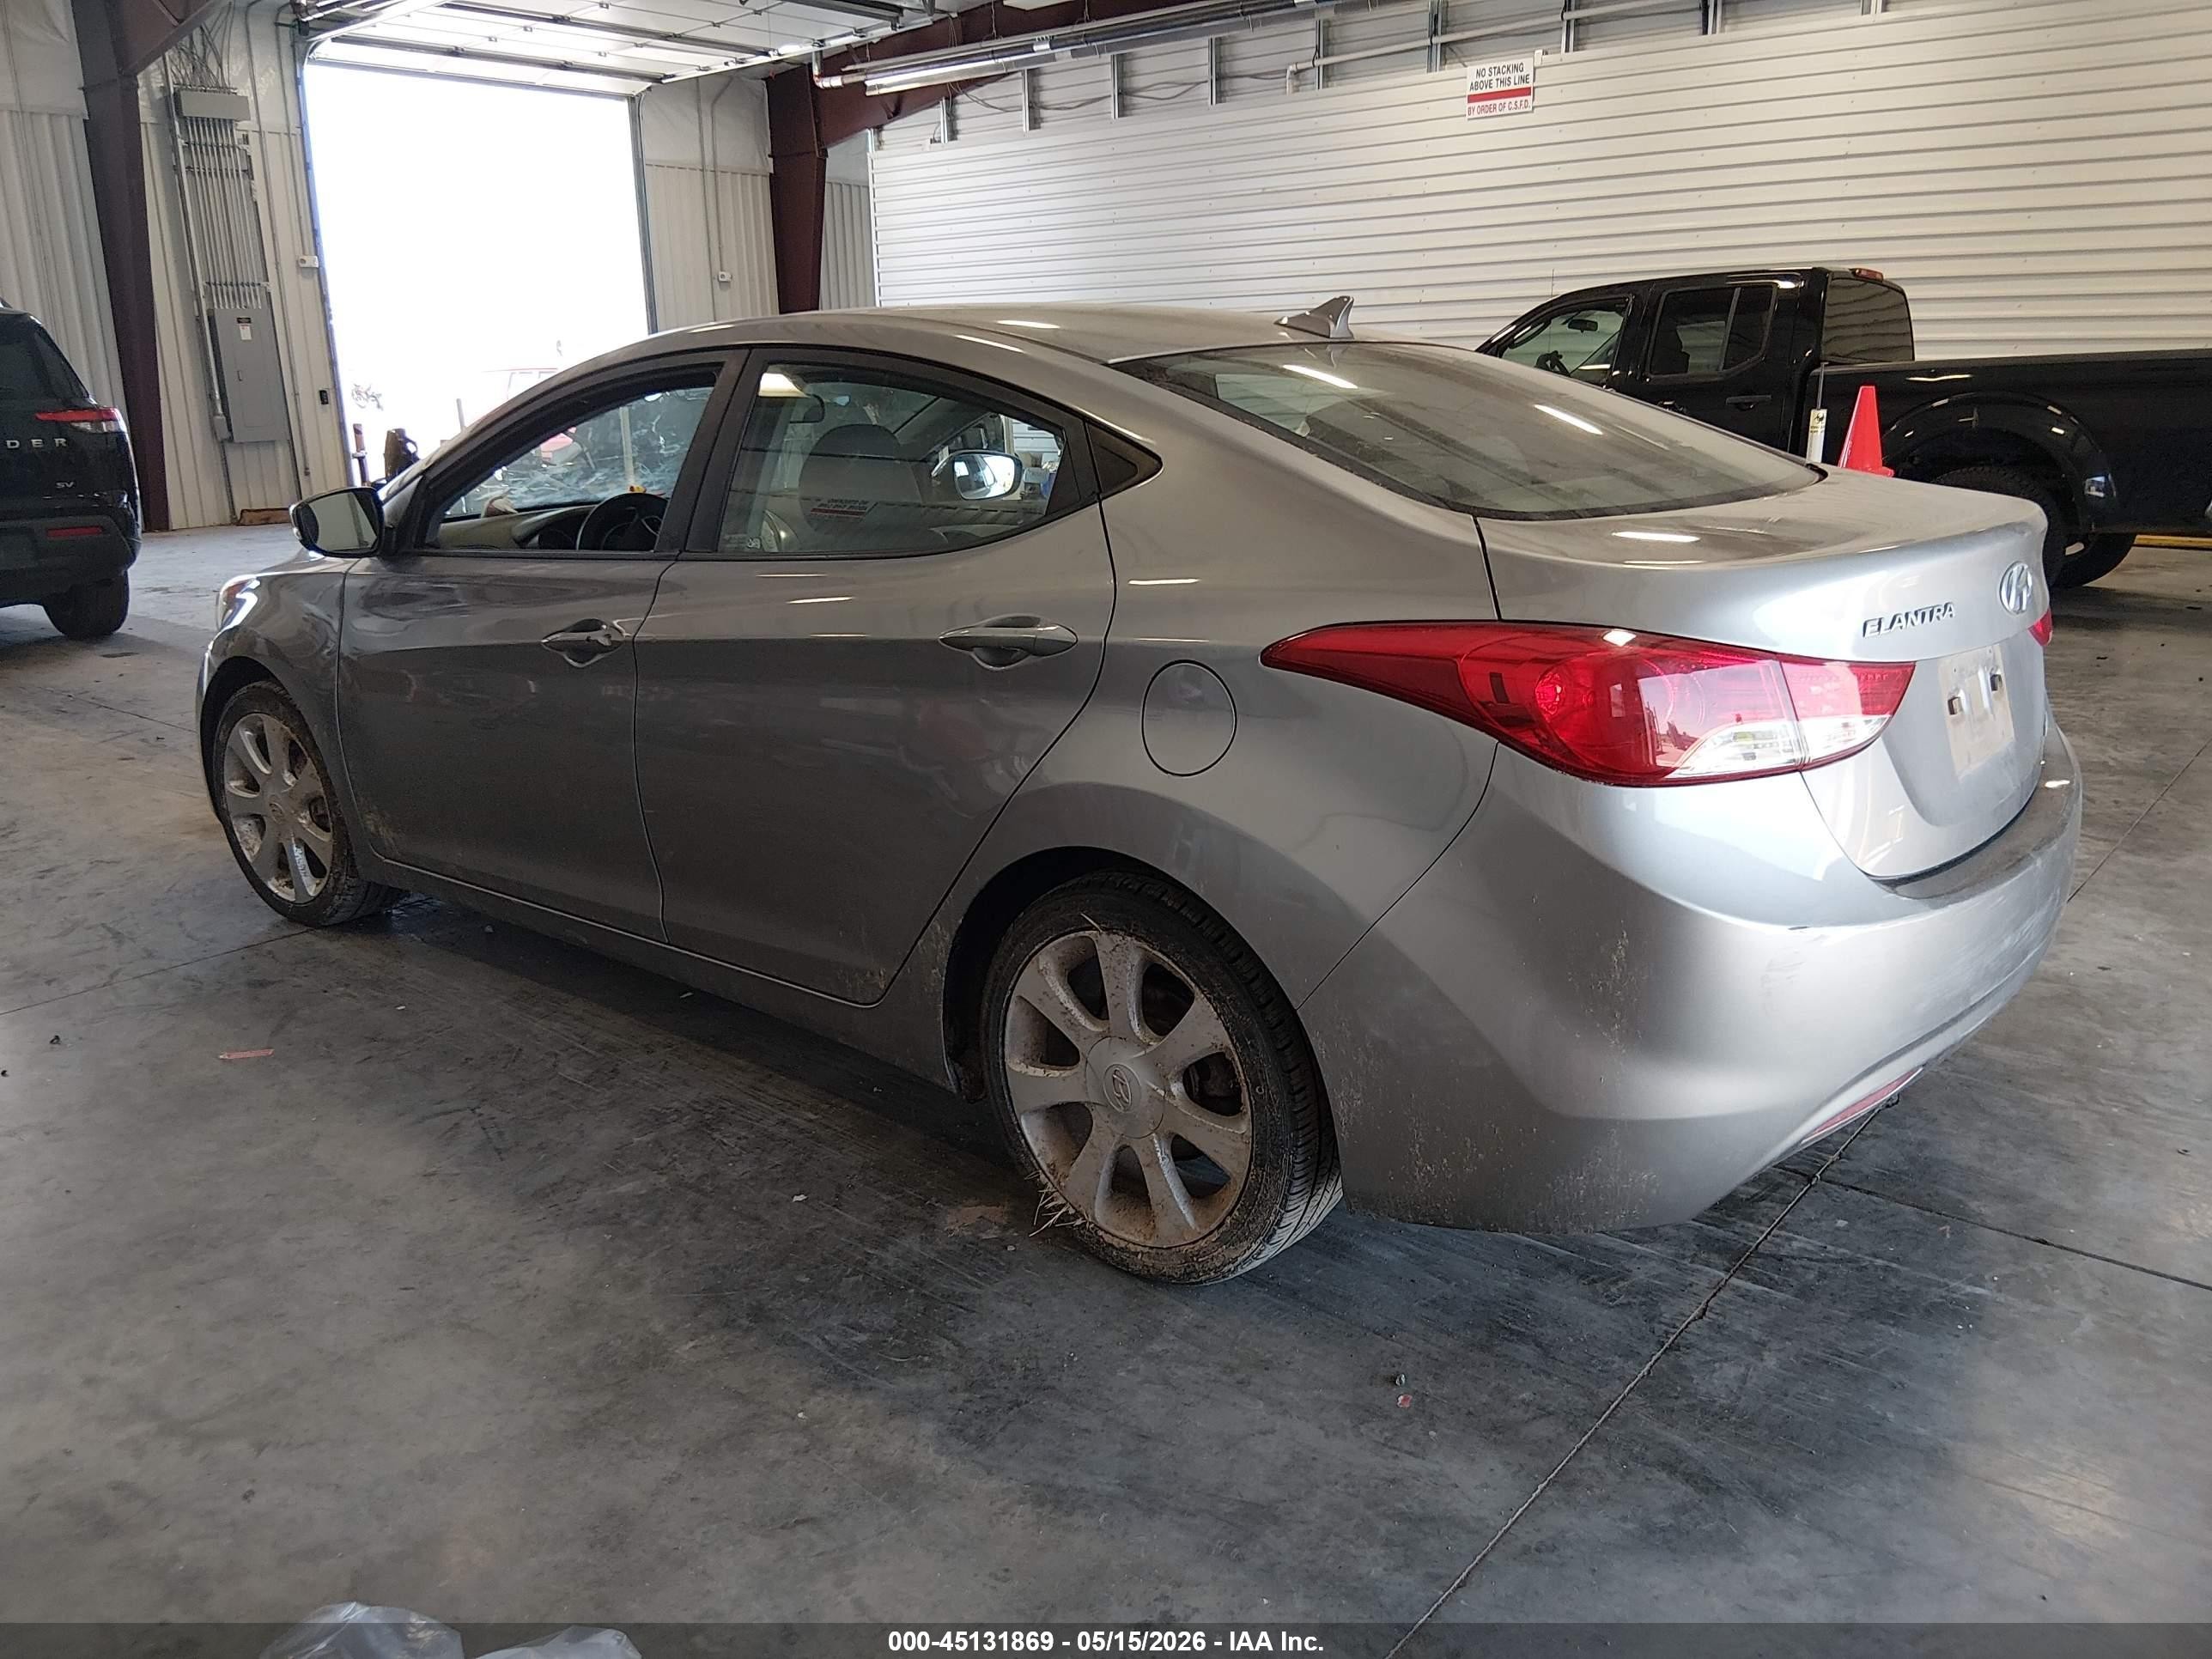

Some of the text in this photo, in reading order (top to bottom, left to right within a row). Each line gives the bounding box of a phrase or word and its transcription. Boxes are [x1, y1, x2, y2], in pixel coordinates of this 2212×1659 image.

[1475, 62, 1524, 79] NO STACKING
[1469, 74, 1530, 92] ABOVE THIS LINE
[1468, 105, 1476, 116] BY
[1476, 103, 1498, 115] ORDER
[1498, 102, 1506, 112] OF
[6, 438, 69, 449] DER
[1863, 602, 1955, 638] ELANTRA
